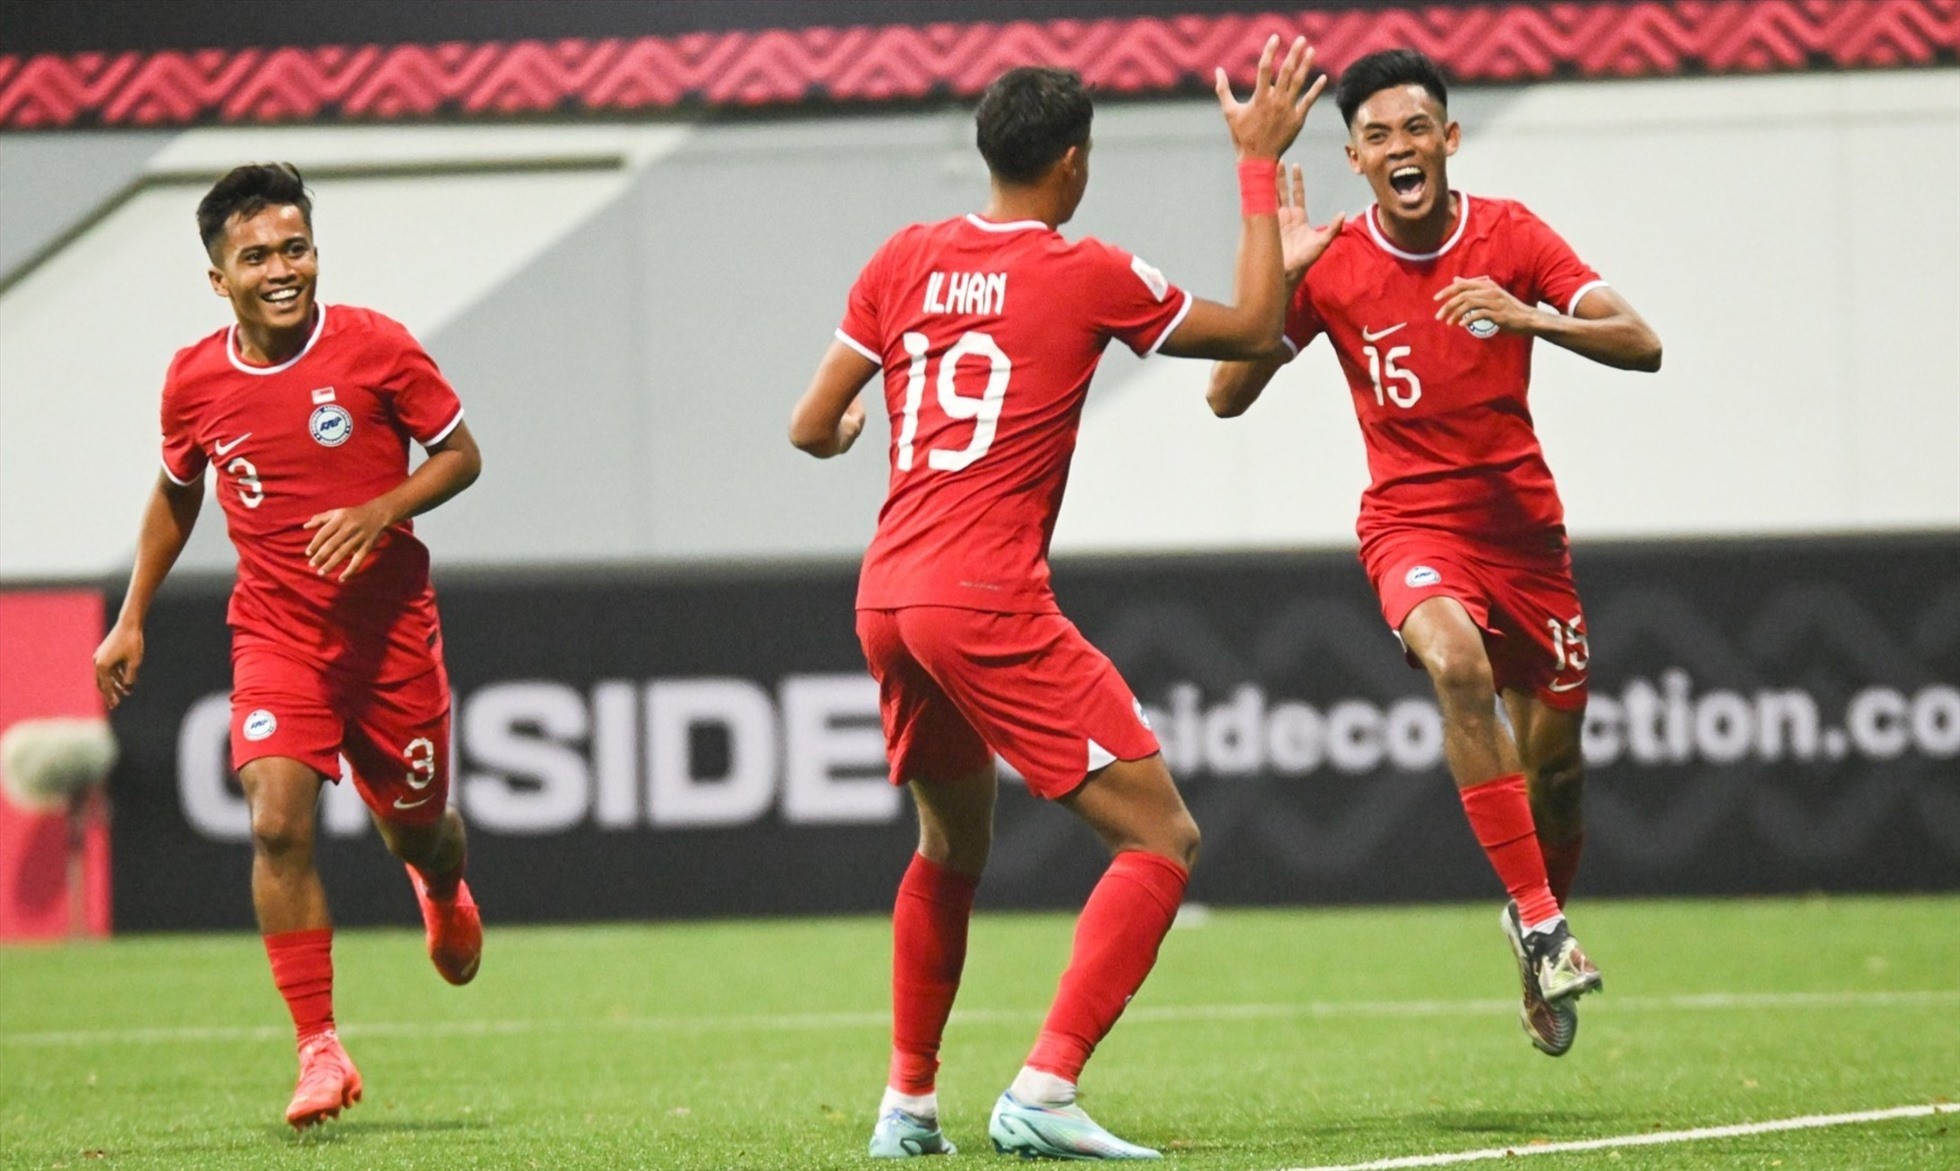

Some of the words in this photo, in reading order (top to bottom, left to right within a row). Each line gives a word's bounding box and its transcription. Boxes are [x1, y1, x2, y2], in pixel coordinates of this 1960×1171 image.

[922, 270, 1007, 315] ILHAN
[896, 330, 1012, 472] 19
[1362, 345, 1442, 409] 15
[227, 456, 265, 509] 3
[1547, 613, 1590, 672] 15
[177, 674, 903, 840] OSIDE
[403, 736, 435, 790] 3
